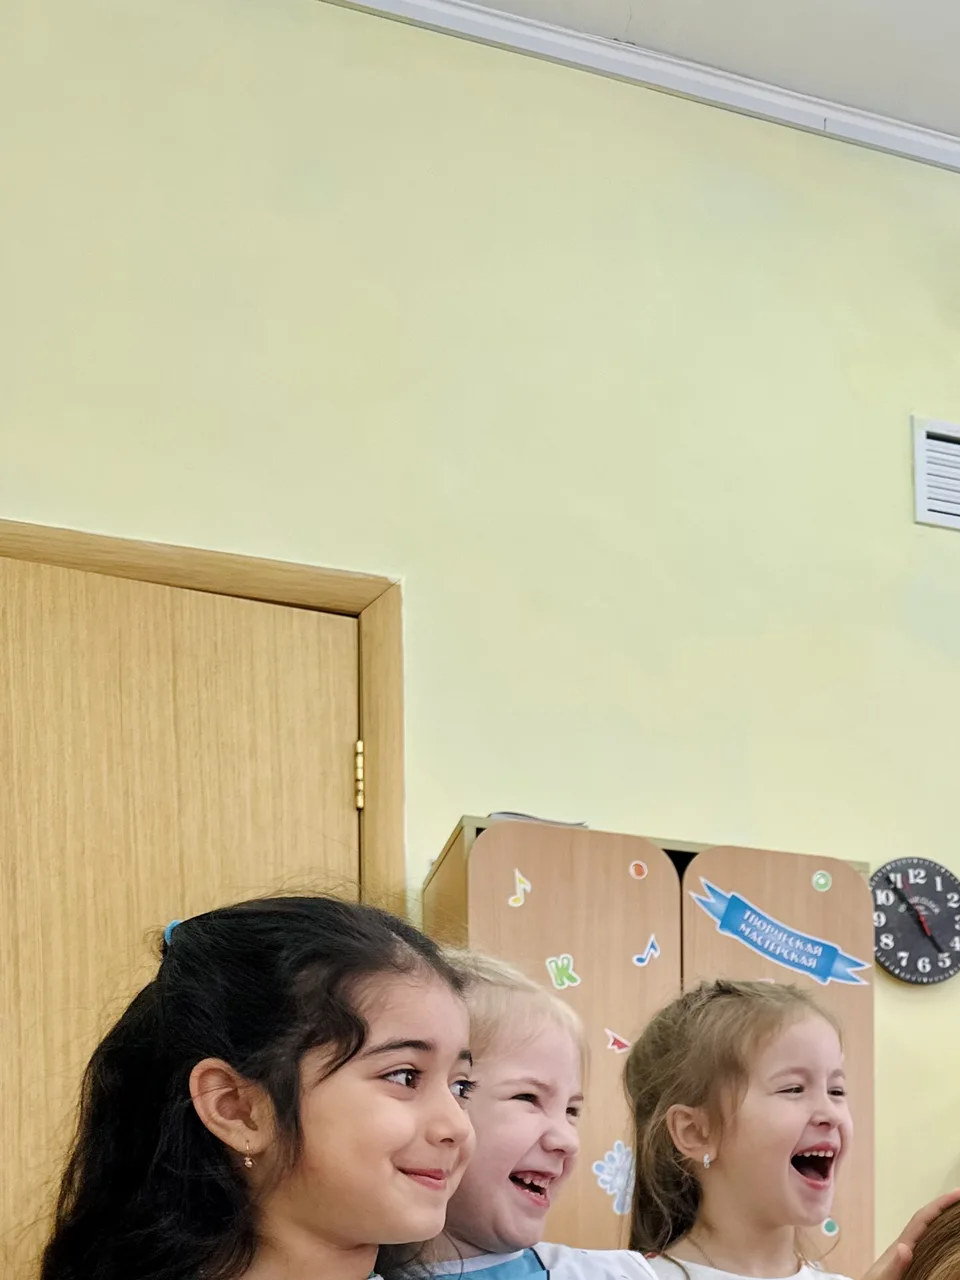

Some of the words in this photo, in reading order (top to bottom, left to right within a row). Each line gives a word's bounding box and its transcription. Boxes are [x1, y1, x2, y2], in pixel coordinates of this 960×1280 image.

[908, 868, 928, 884] 12
[934, 876, 943, 892] 1
[875, 889, 895, 906] 10
[946, 892, 960, 908] 2
[873, 911, 887, 927] 9
[739, 923, 818, 970] МАСТЕРСКАЯ
[880, 933, 895, 949] 8
[897, 951, 910, 967] 7
[917, 957, 932, 973] 6
[937, 951, 952, 968] 5
